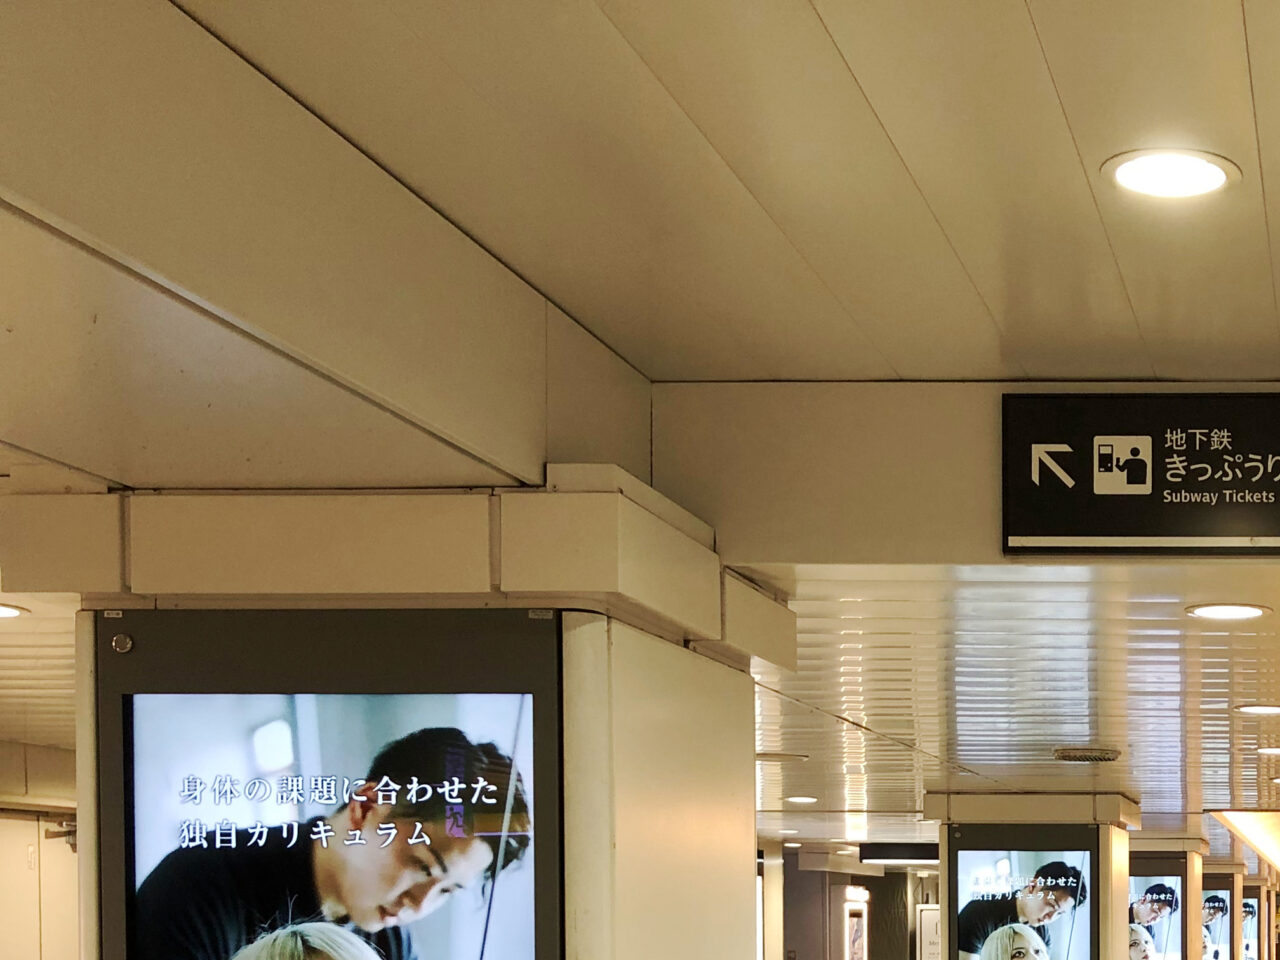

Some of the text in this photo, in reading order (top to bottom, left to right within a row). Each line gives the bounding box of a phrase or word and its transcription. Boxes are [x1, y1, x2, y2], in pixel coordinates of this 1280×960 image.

[1165, 428, 1233, 450] 地下鉄
[1163, 490, 1275, 506] Subway Tickets
[180, 775, 499, 806] 身体の課題に合わせた
[180, 819, 432, 850] 独自カリキュラム
